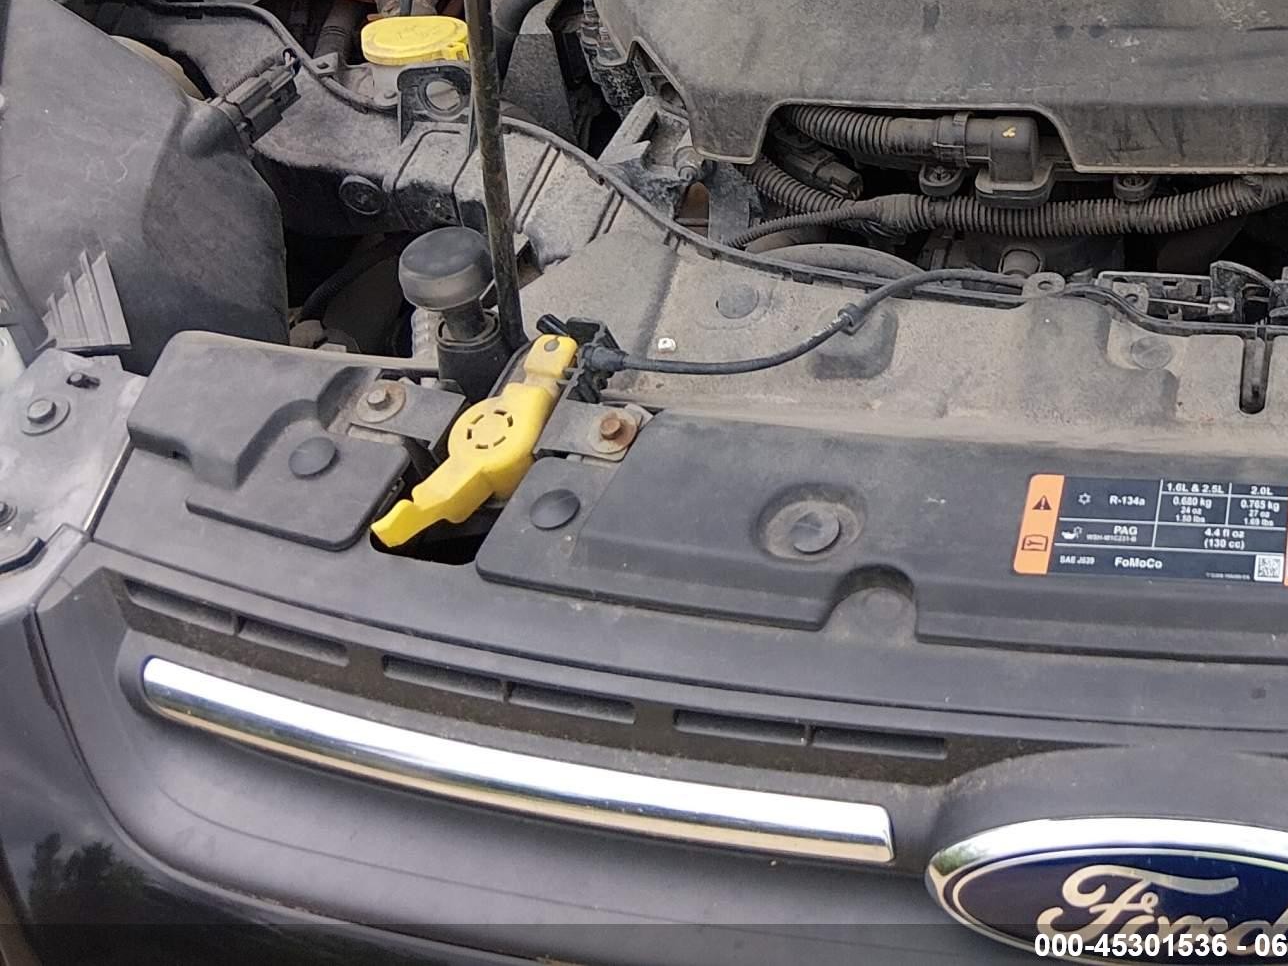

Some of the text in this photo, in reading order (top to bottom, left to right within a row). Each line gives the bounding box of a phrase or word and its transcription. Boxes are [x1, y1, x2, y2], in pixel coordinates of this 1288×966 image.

[1167, 482, 1225, 494] 1.6L & 2.5L
[1250, 485, 1274, 496] 2.0L
[1109, 495, 1146, 507] R-134a
[1199, 496, 1212, 510] kg
[1267, 499, 1280, 513] kg
[1193, 514, 1206, 524] lbs
[1261, 517, 1274, 527] lbs
[1113, 525, 1138, 536] PAG
[1204, 527, 1245, 539] 4.4 fl oz
[1203, 537, 1246, 550] (130 cc)
[1059, 554, 1076, 564] SAE
[1114, 556, 1163, 570] FoMoCo
